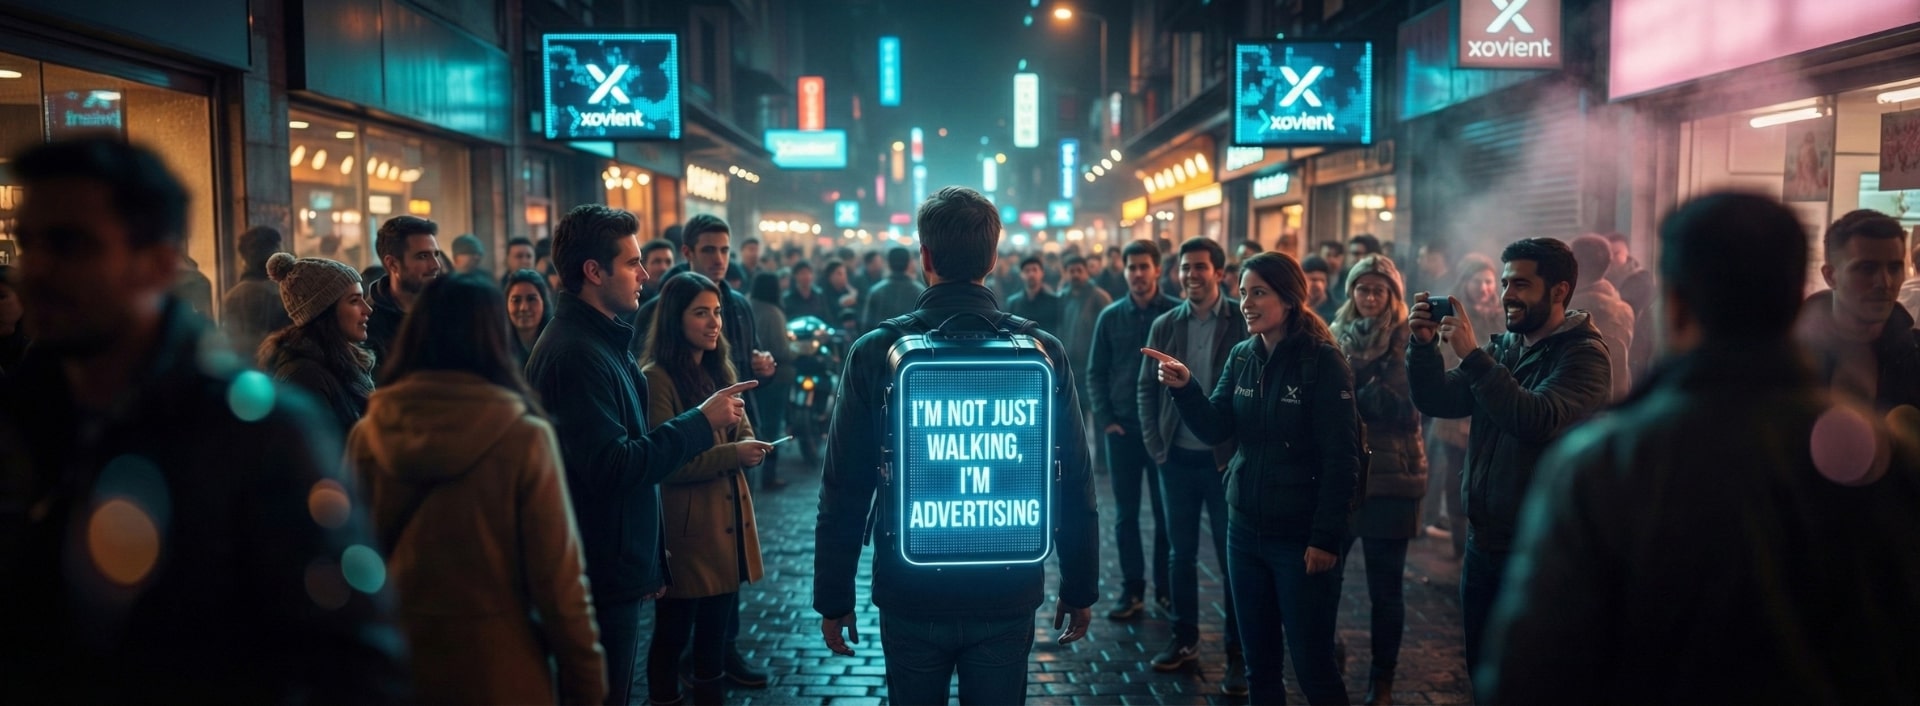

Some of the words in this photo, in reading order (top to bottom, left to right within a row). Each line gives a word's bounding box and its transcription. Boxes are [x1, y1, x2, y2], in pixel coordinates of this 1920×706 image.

[1467, 36, 1553, 58] xovient
[580, 108, 645, 127] xovient
[1269, 111, 1336, 131] xovient
[911, 399, 942, 427] I'M
[948, 399, 987, 427] NOT
[991, 398, 1039, 427] JUST
[927, 432, 1023, 463] WALKING,
[960, 466, 990, 494] I'M
[909, 498, 1040, 528] ADVERTISING
